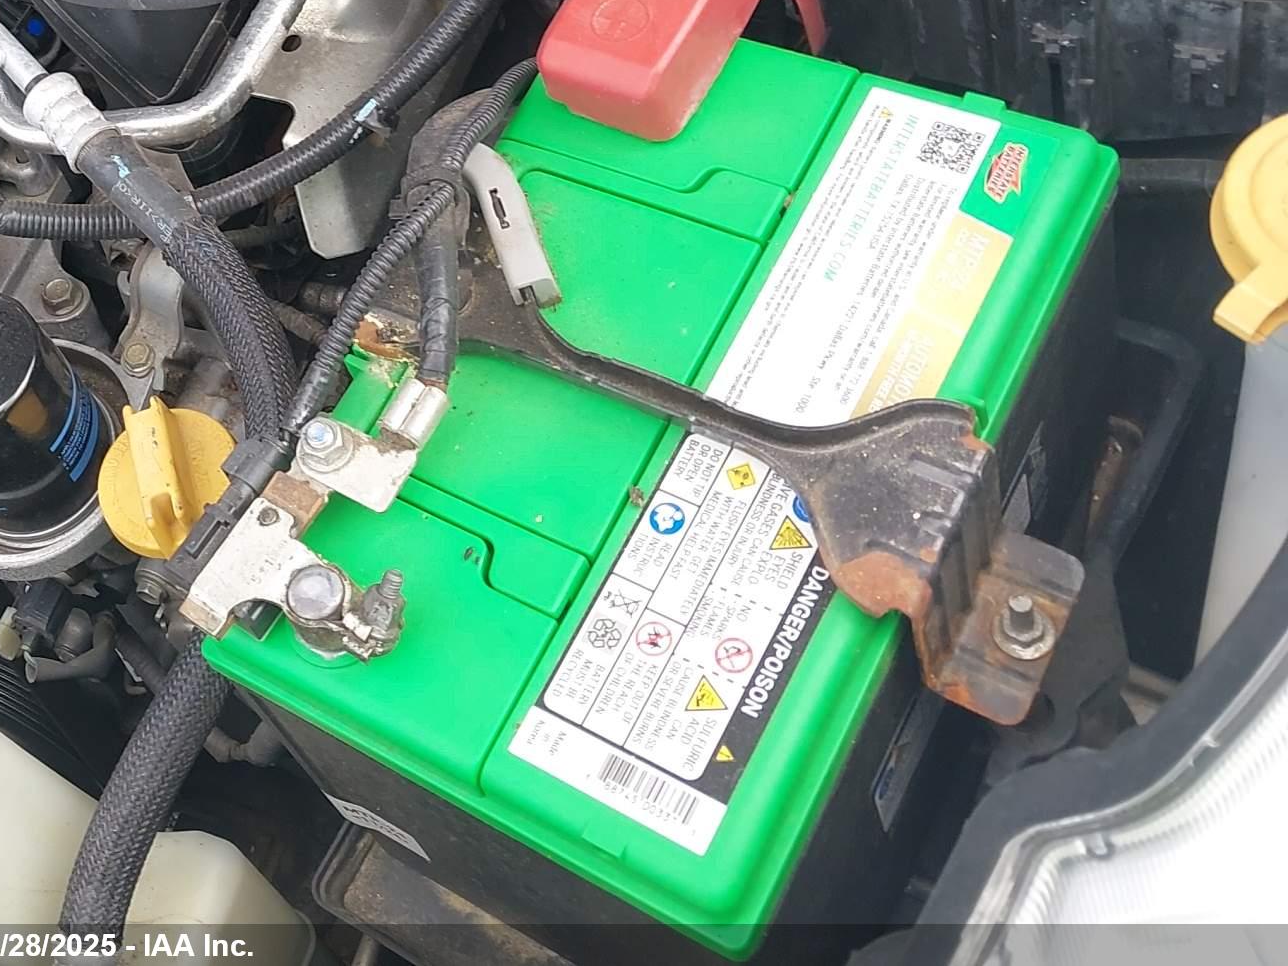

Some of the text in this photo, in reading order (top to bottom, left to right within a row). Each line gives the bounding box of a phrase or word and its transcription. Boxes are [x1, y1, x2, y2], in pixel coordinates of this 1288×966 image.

[984, 144, 1017, 193] BATTERIES
[992, 145, 1028, 199] INTERSTATE
[671, 437, 700, 479] BATTERY
[682, 456, 704, 484] OPEN
[697, 461, 716, 483] NOT
[693, 488, 722, 531] MEDICAL
[714, 494, 735, 521] WITH
[749, 471, 782, 522] BLINDNESS
[756, 500, 784, 538] GASES
[625, 530, 649, 561] TIONS
[651, 540, 673, 569] READ
[677, 498, 747, 618] FLUSH EYES IMMEDIATELY
[679, 530, 700, 557] HELP
[725, 534, 748, 567] INJURY
[745, 535, 763, 558] CAN
[729, 556, 752, 587] CAUSE
[762, 553, 786, 583] EYES
[774, 549, 804, 591] SHIELD
[733, 602, 753, 624] NO
[737, 563, 831, 719] DANGER/POISON
[550, 647, 585, 699] RECYCLED
[570, 656, 594, 688] MUST
[575, 662, 606, 708] BATTERY
[638, 662, 660, 690] KEEP
[593, 664, 627, 716] CHILDREN
[609, 676, 636, 714] REACH
[649, 674, 674, 711] SEVERE
[643, 665, 695, 753] CAUSE BLINDNESS
[524, 717, 546, 747] Korea
[546, 729, 567, 757] Made
[630, 710, 655, 745] BURNS
[678, 716, 701, 746] ACID
[680, 715, 718, 772] SULFURIC
